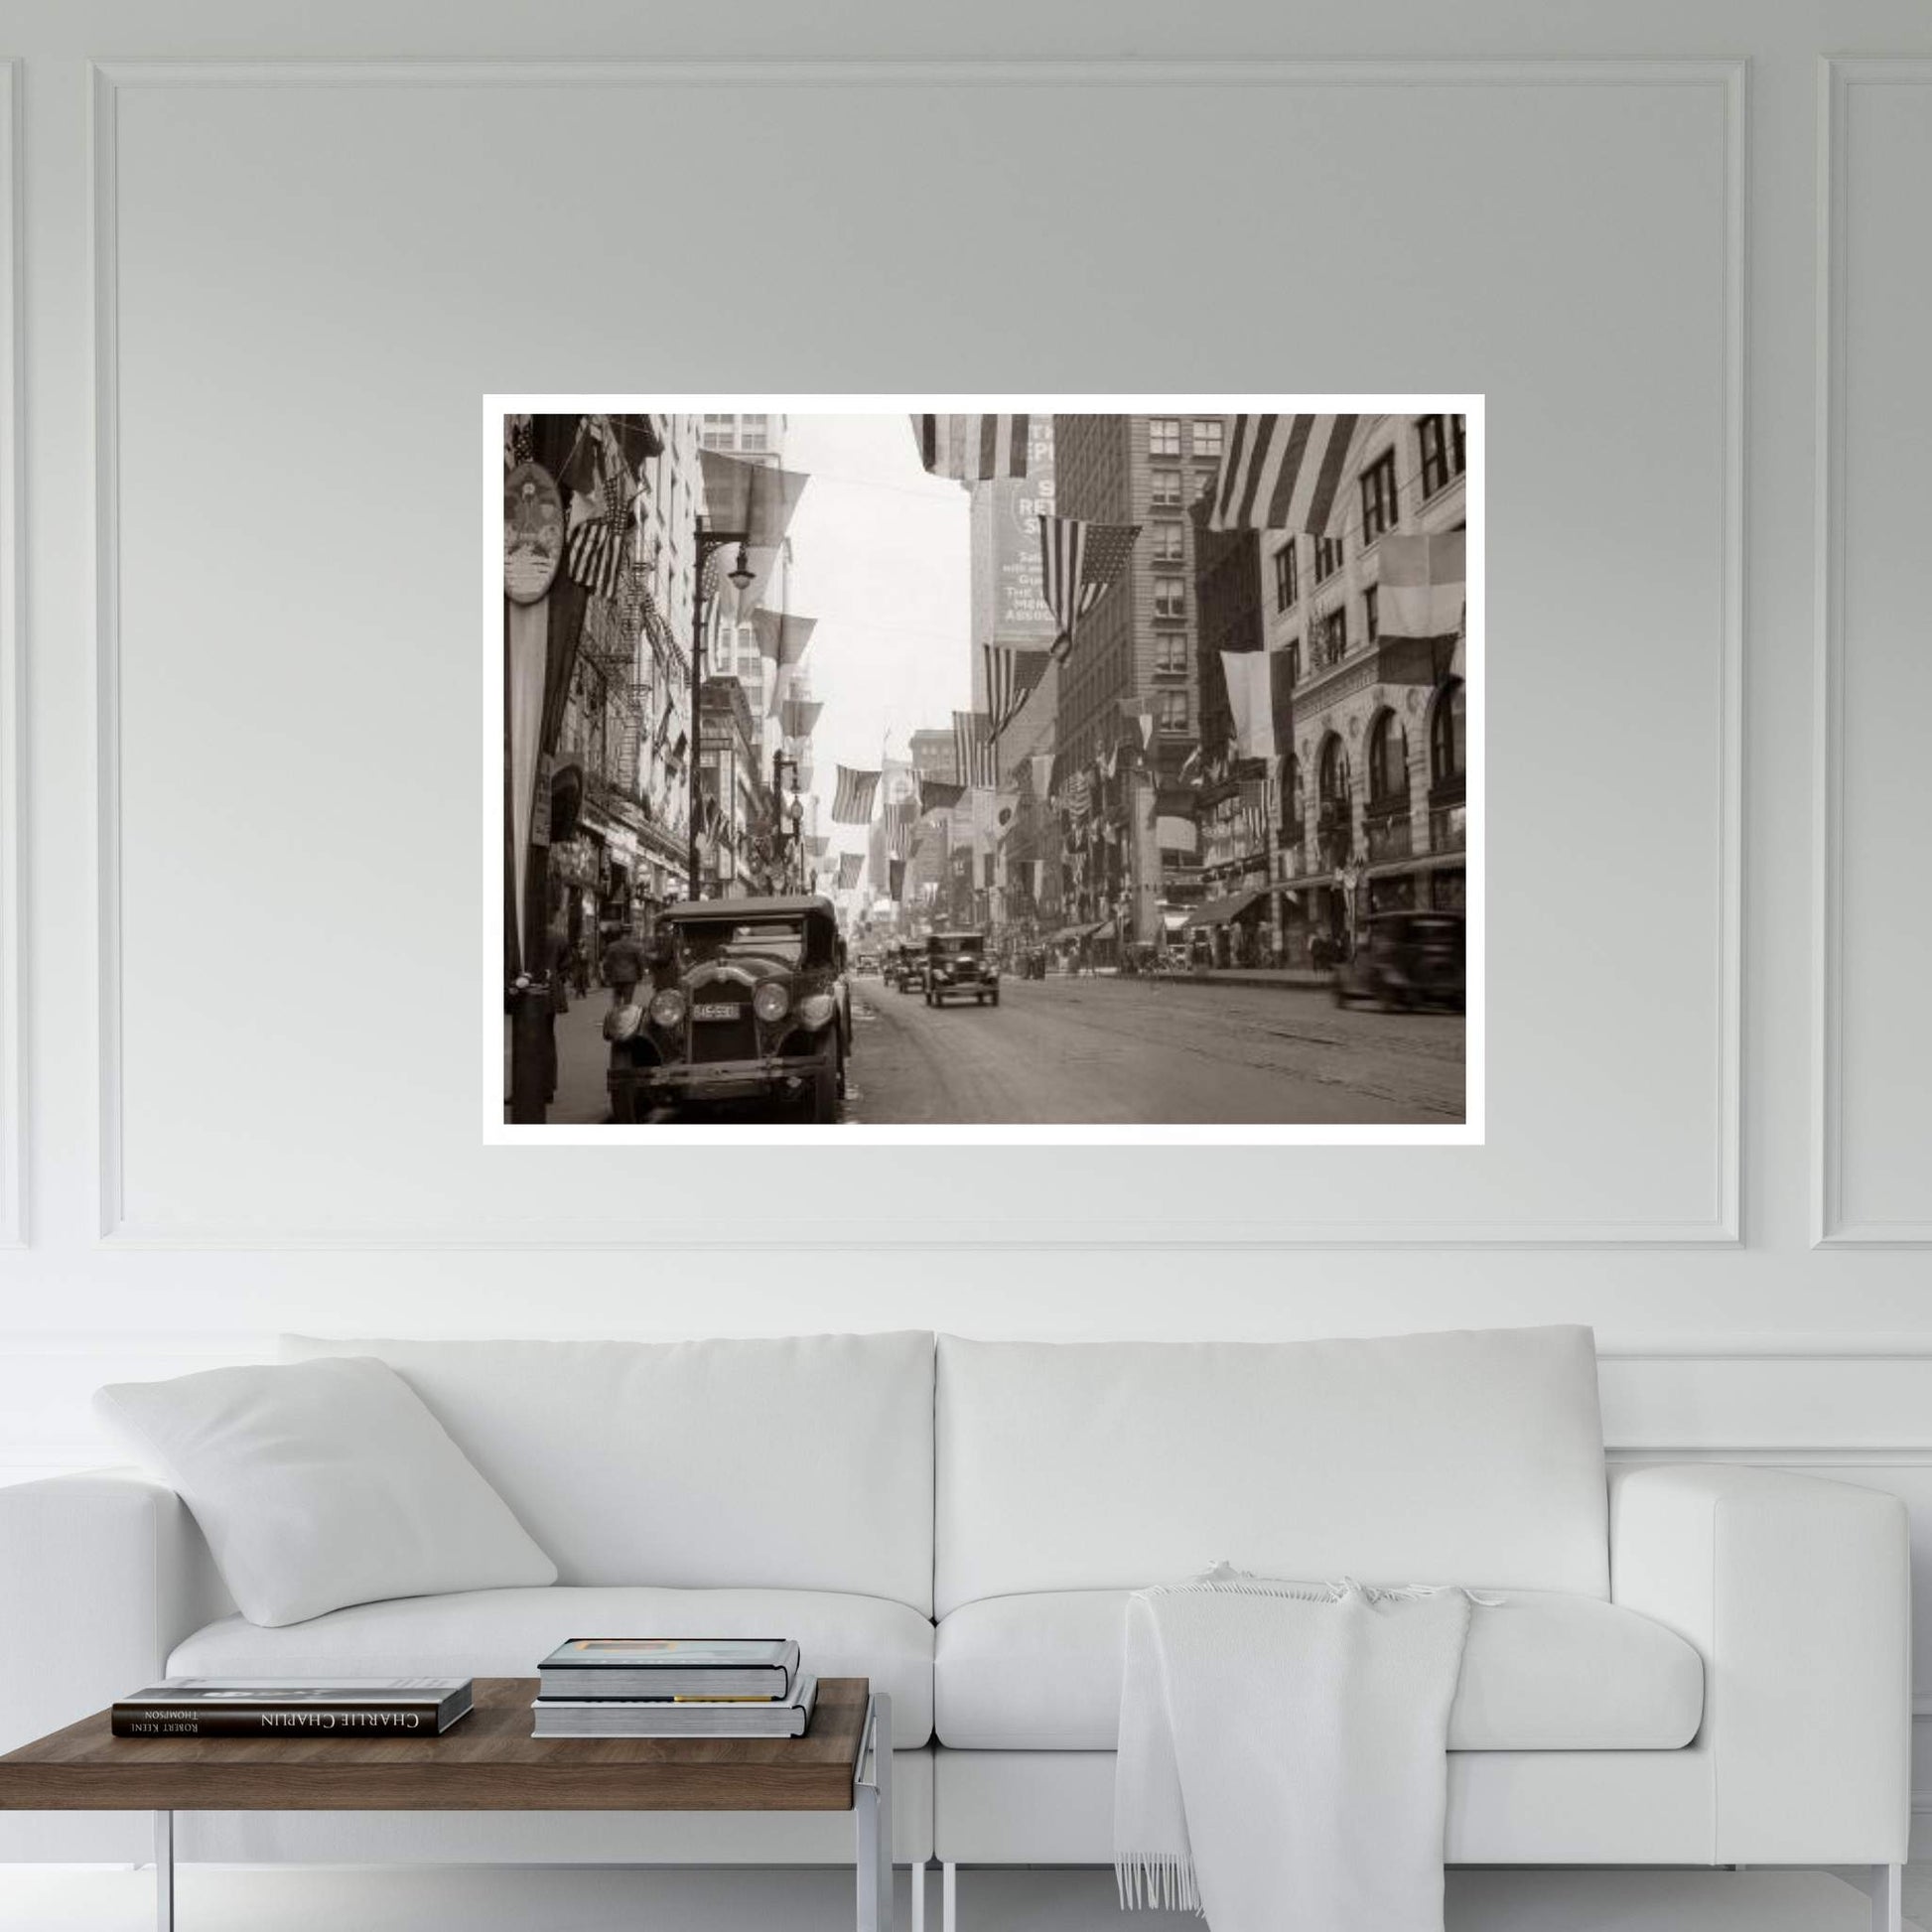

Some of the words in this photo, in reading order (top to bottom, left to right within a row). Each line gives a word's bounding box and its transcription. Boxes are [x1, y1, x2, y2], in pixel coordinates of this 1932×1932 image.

[144, 1711, 199, 1721] THOMPSON
[261, 1713, 336, 1728] CHAPLIN
[342, 1713, 419, 1728] CHARLIE
[162, 1723, 199, 1733] ROBERT
